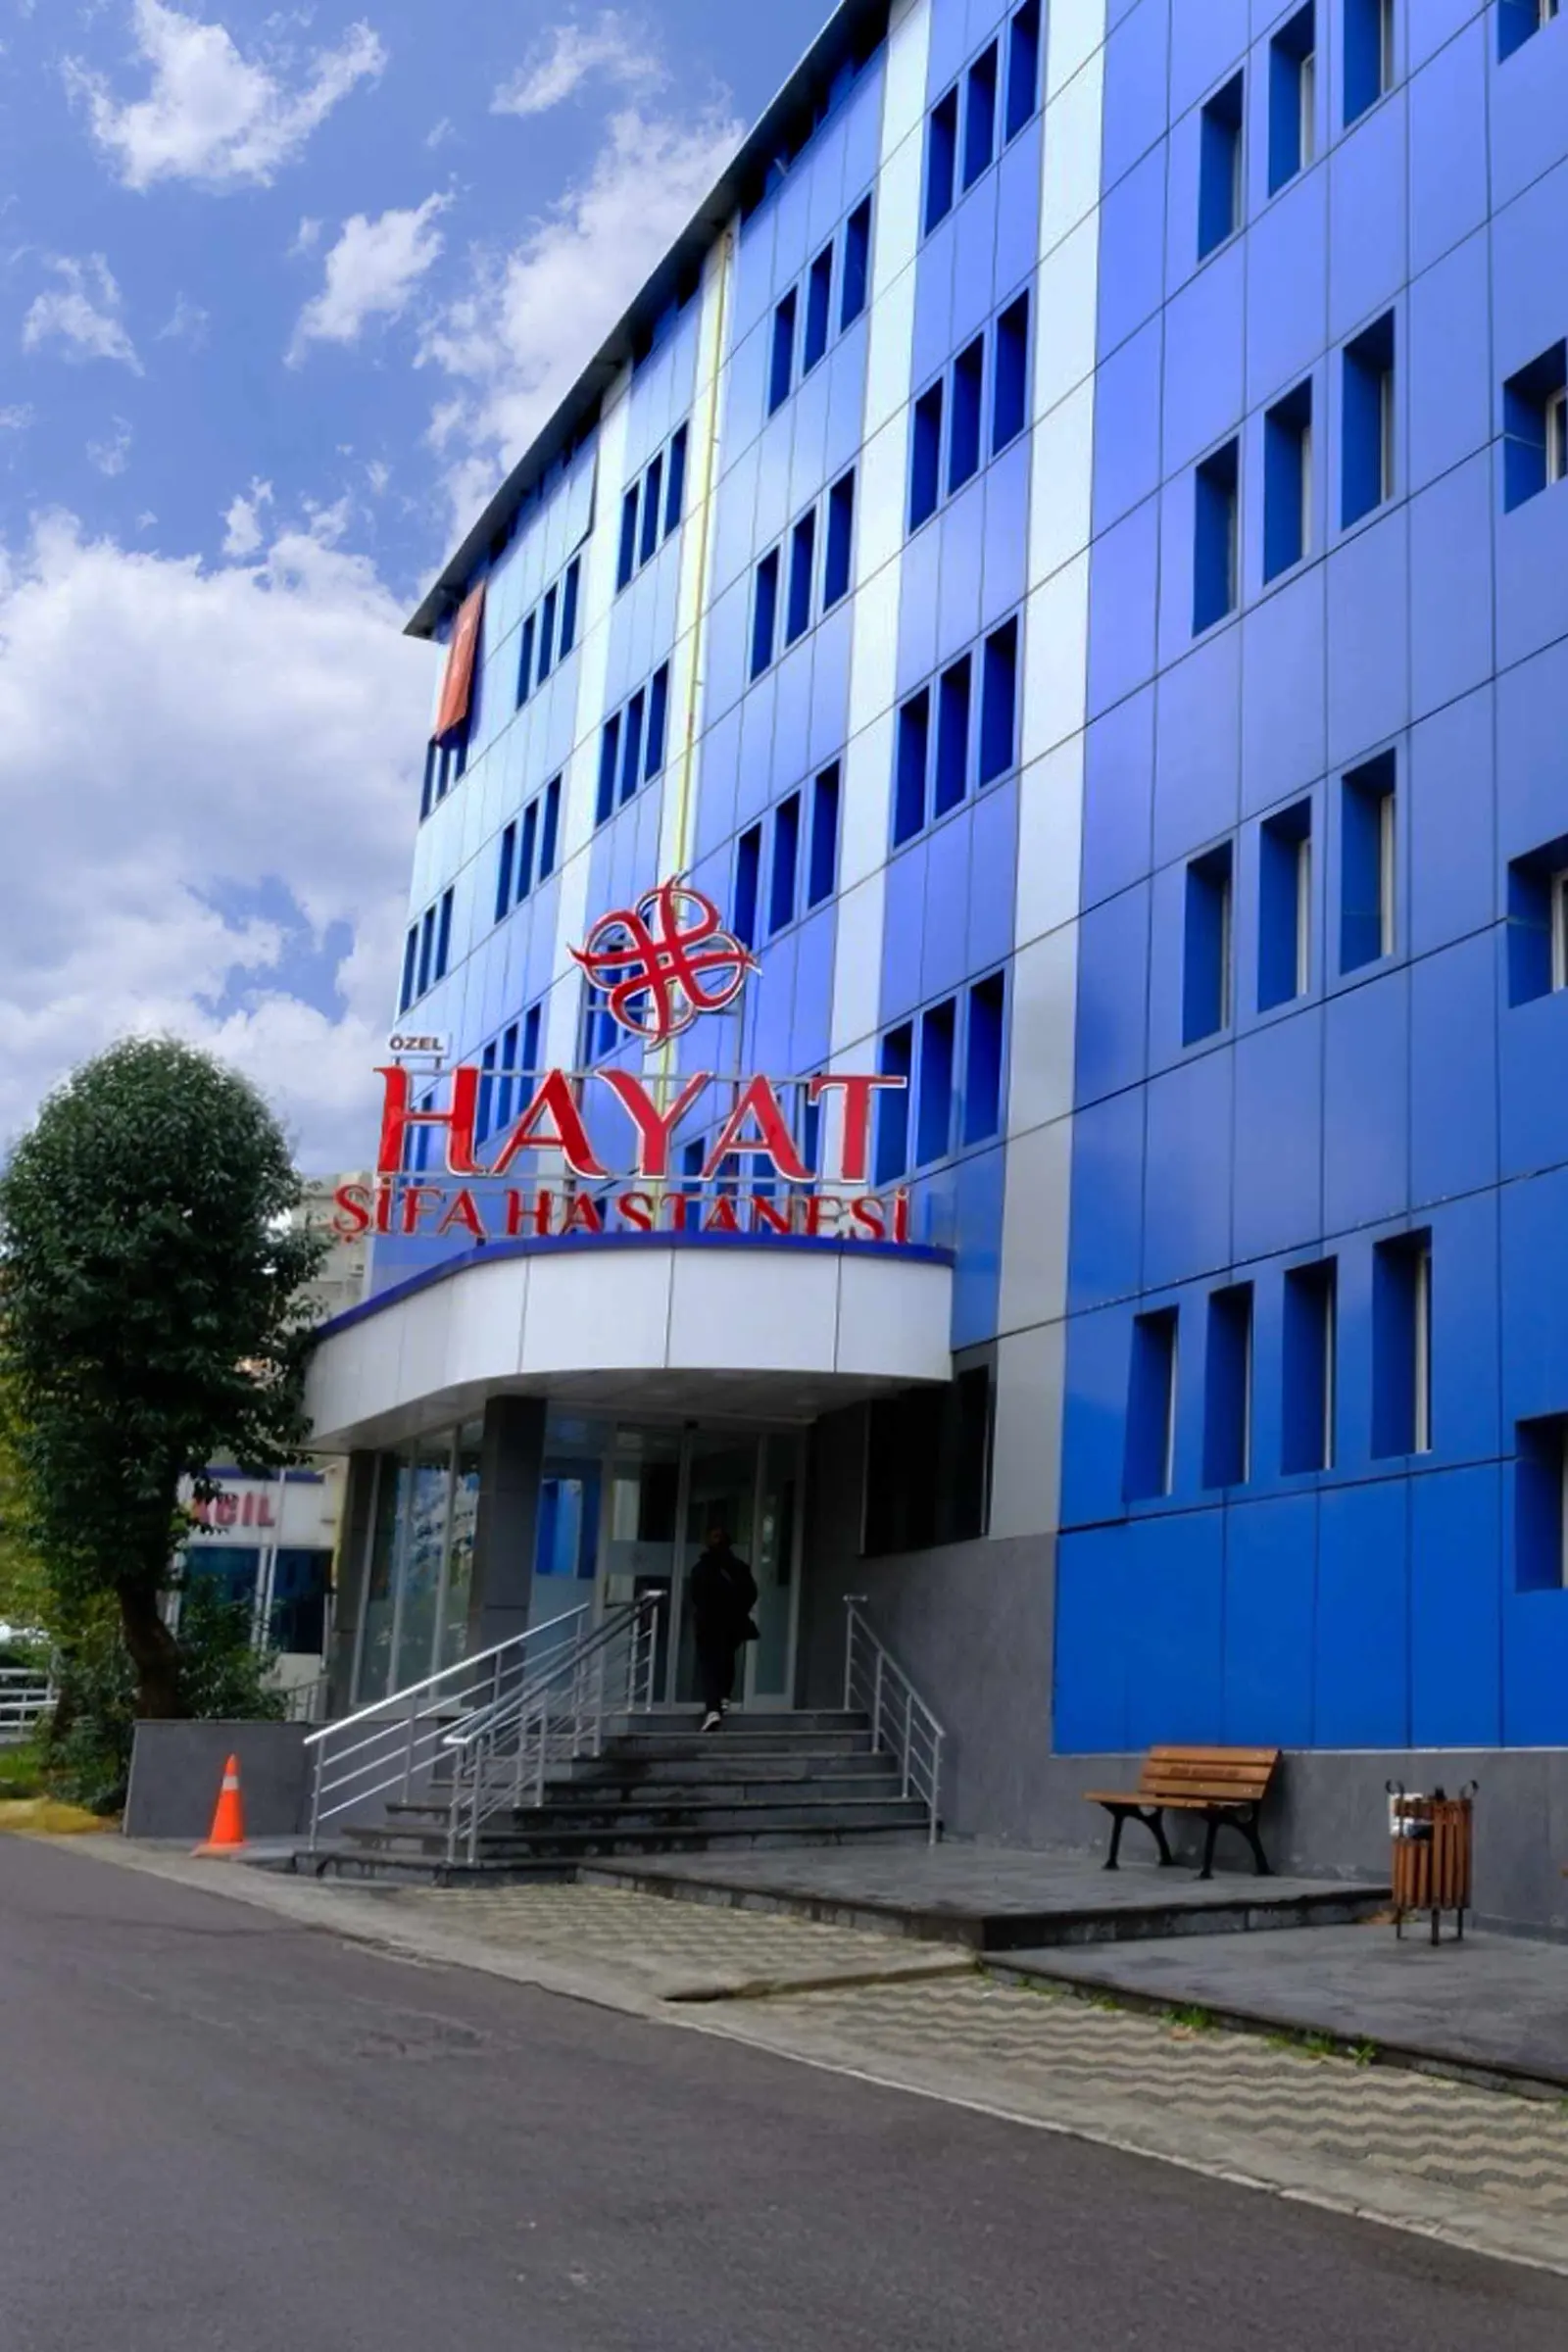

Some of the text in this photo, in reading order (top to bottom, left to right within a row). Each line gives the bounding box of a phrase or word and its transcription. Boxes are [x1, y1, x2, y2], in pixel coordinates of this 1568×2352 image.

[389, 1033, 444, 1052] ÖZEL
[372, 1066, 907, 1184] HAYAT
[331, 1177, 909, 1244] ŞİFA HASTANESİ
